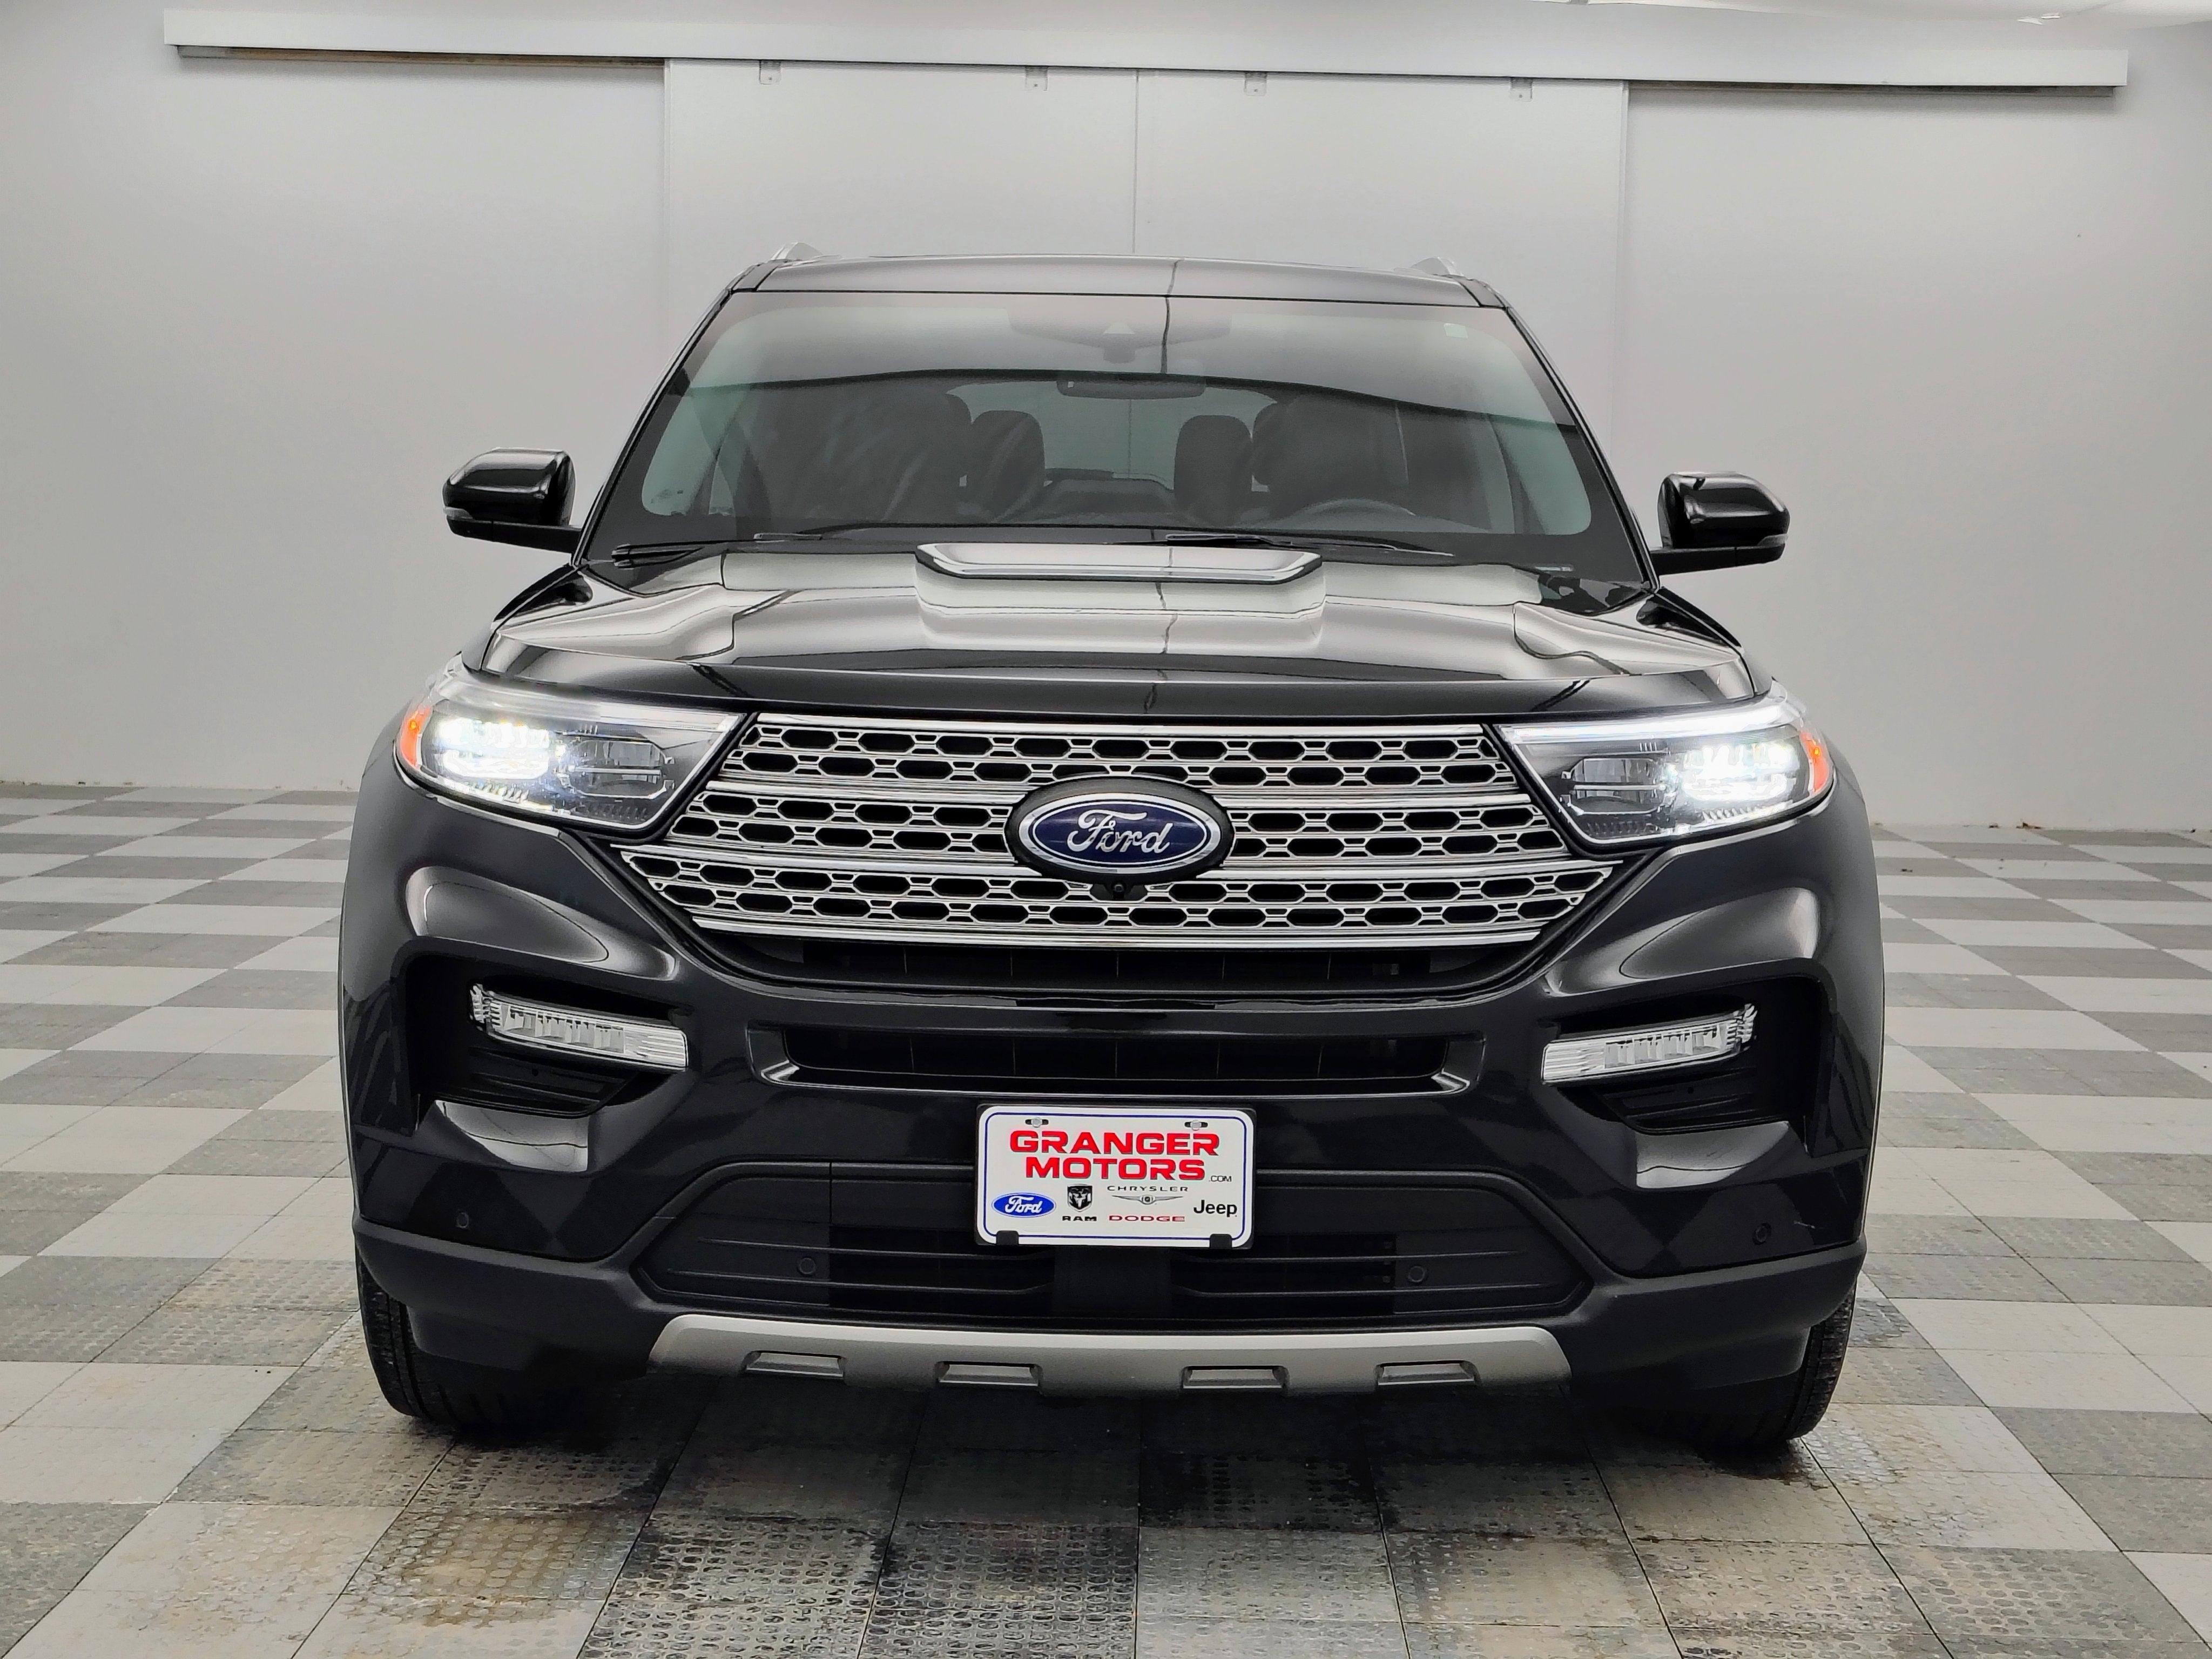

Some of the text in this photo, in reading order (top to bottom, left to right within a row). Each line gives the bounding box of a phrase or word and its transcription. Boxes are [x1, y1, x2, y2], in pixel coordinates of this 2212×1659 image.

[1067, 809, 1174, 853] Ford
[1010, 1130, 1219, 1156] GRANGER
[1026, 1157, 1205, 1181] MOTORS
[1004, 1196, 1043, 1215] Ford
[1193, 1199, 1237, 1217] Jeep
